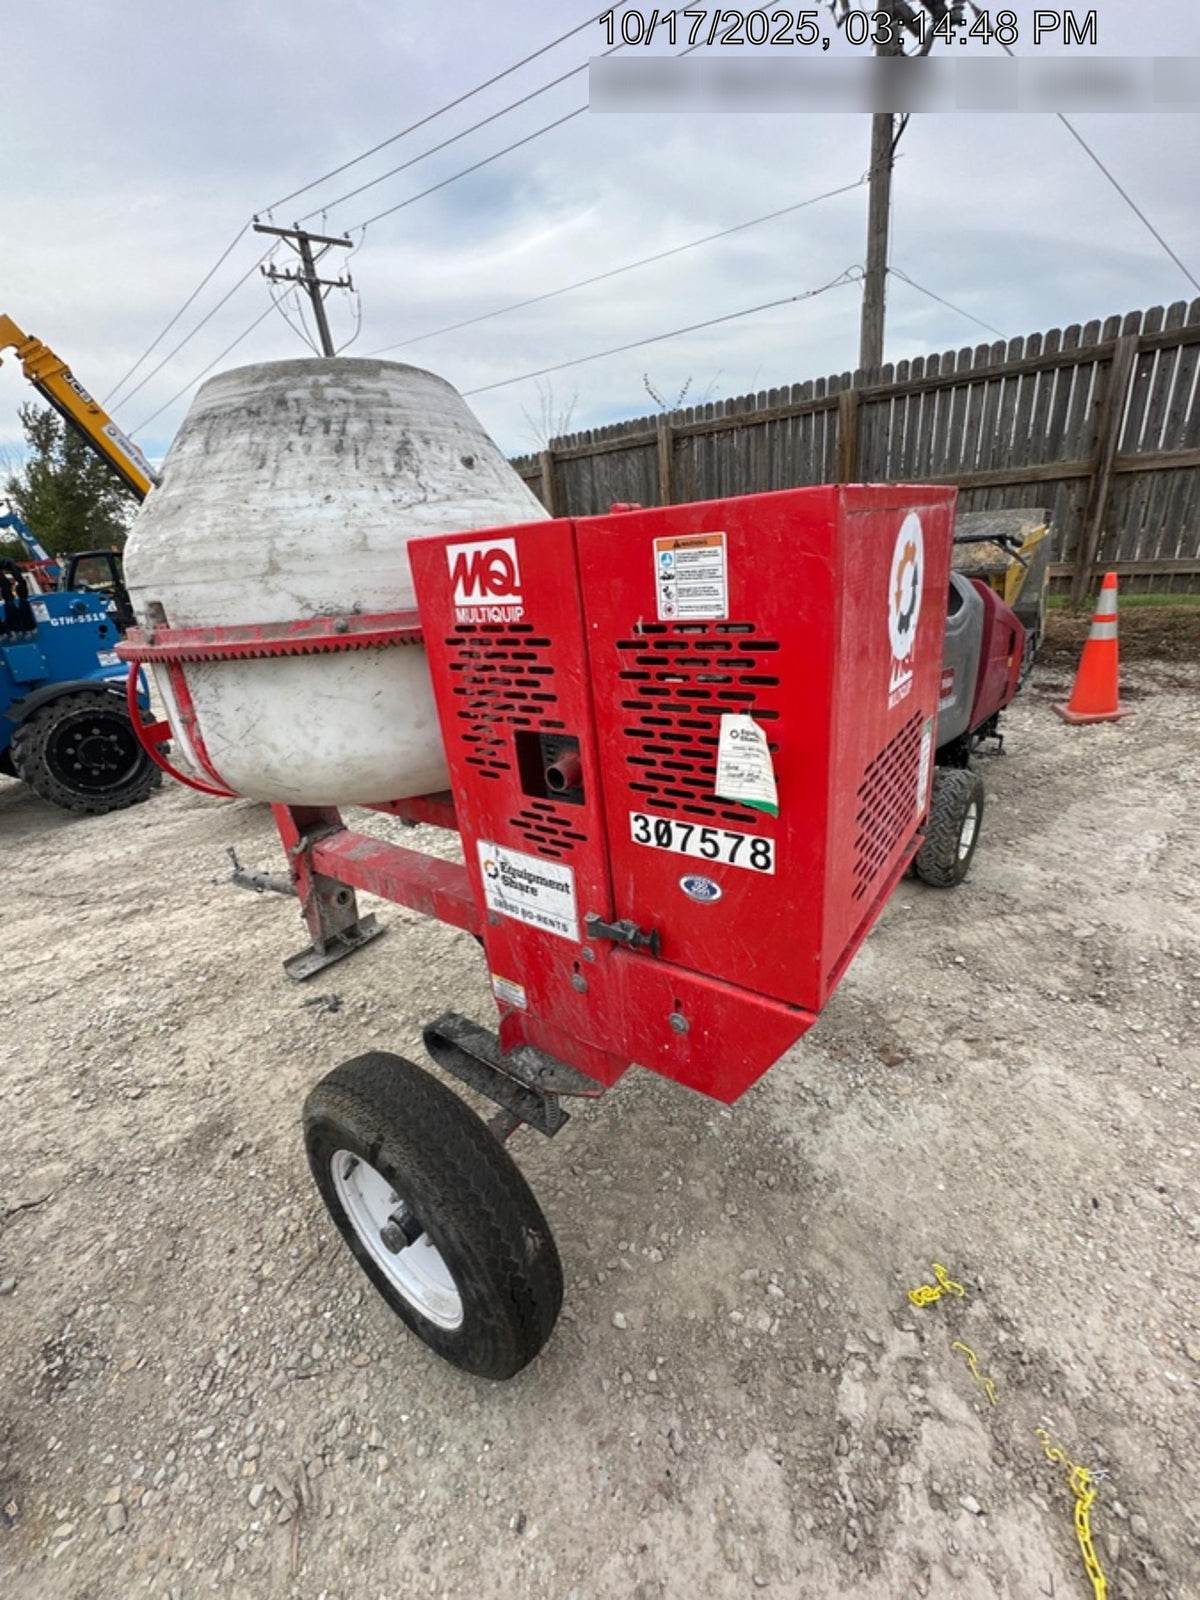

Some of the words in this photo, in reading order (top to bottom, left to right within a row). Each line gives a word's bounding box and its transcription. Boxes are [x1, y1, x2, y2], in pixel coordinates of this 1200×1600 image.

[62, 371, 93, 404] JCB
[447, 547, 522, 598] MQ
[50, 612, 107, 627] GTH-5519
[456, 605, 525, 624] MULTIQUIP
[633, 814, 772, 870] 307578
[499, 860, 571, 895] Equipment
[500, 873, 539, 897] Share
